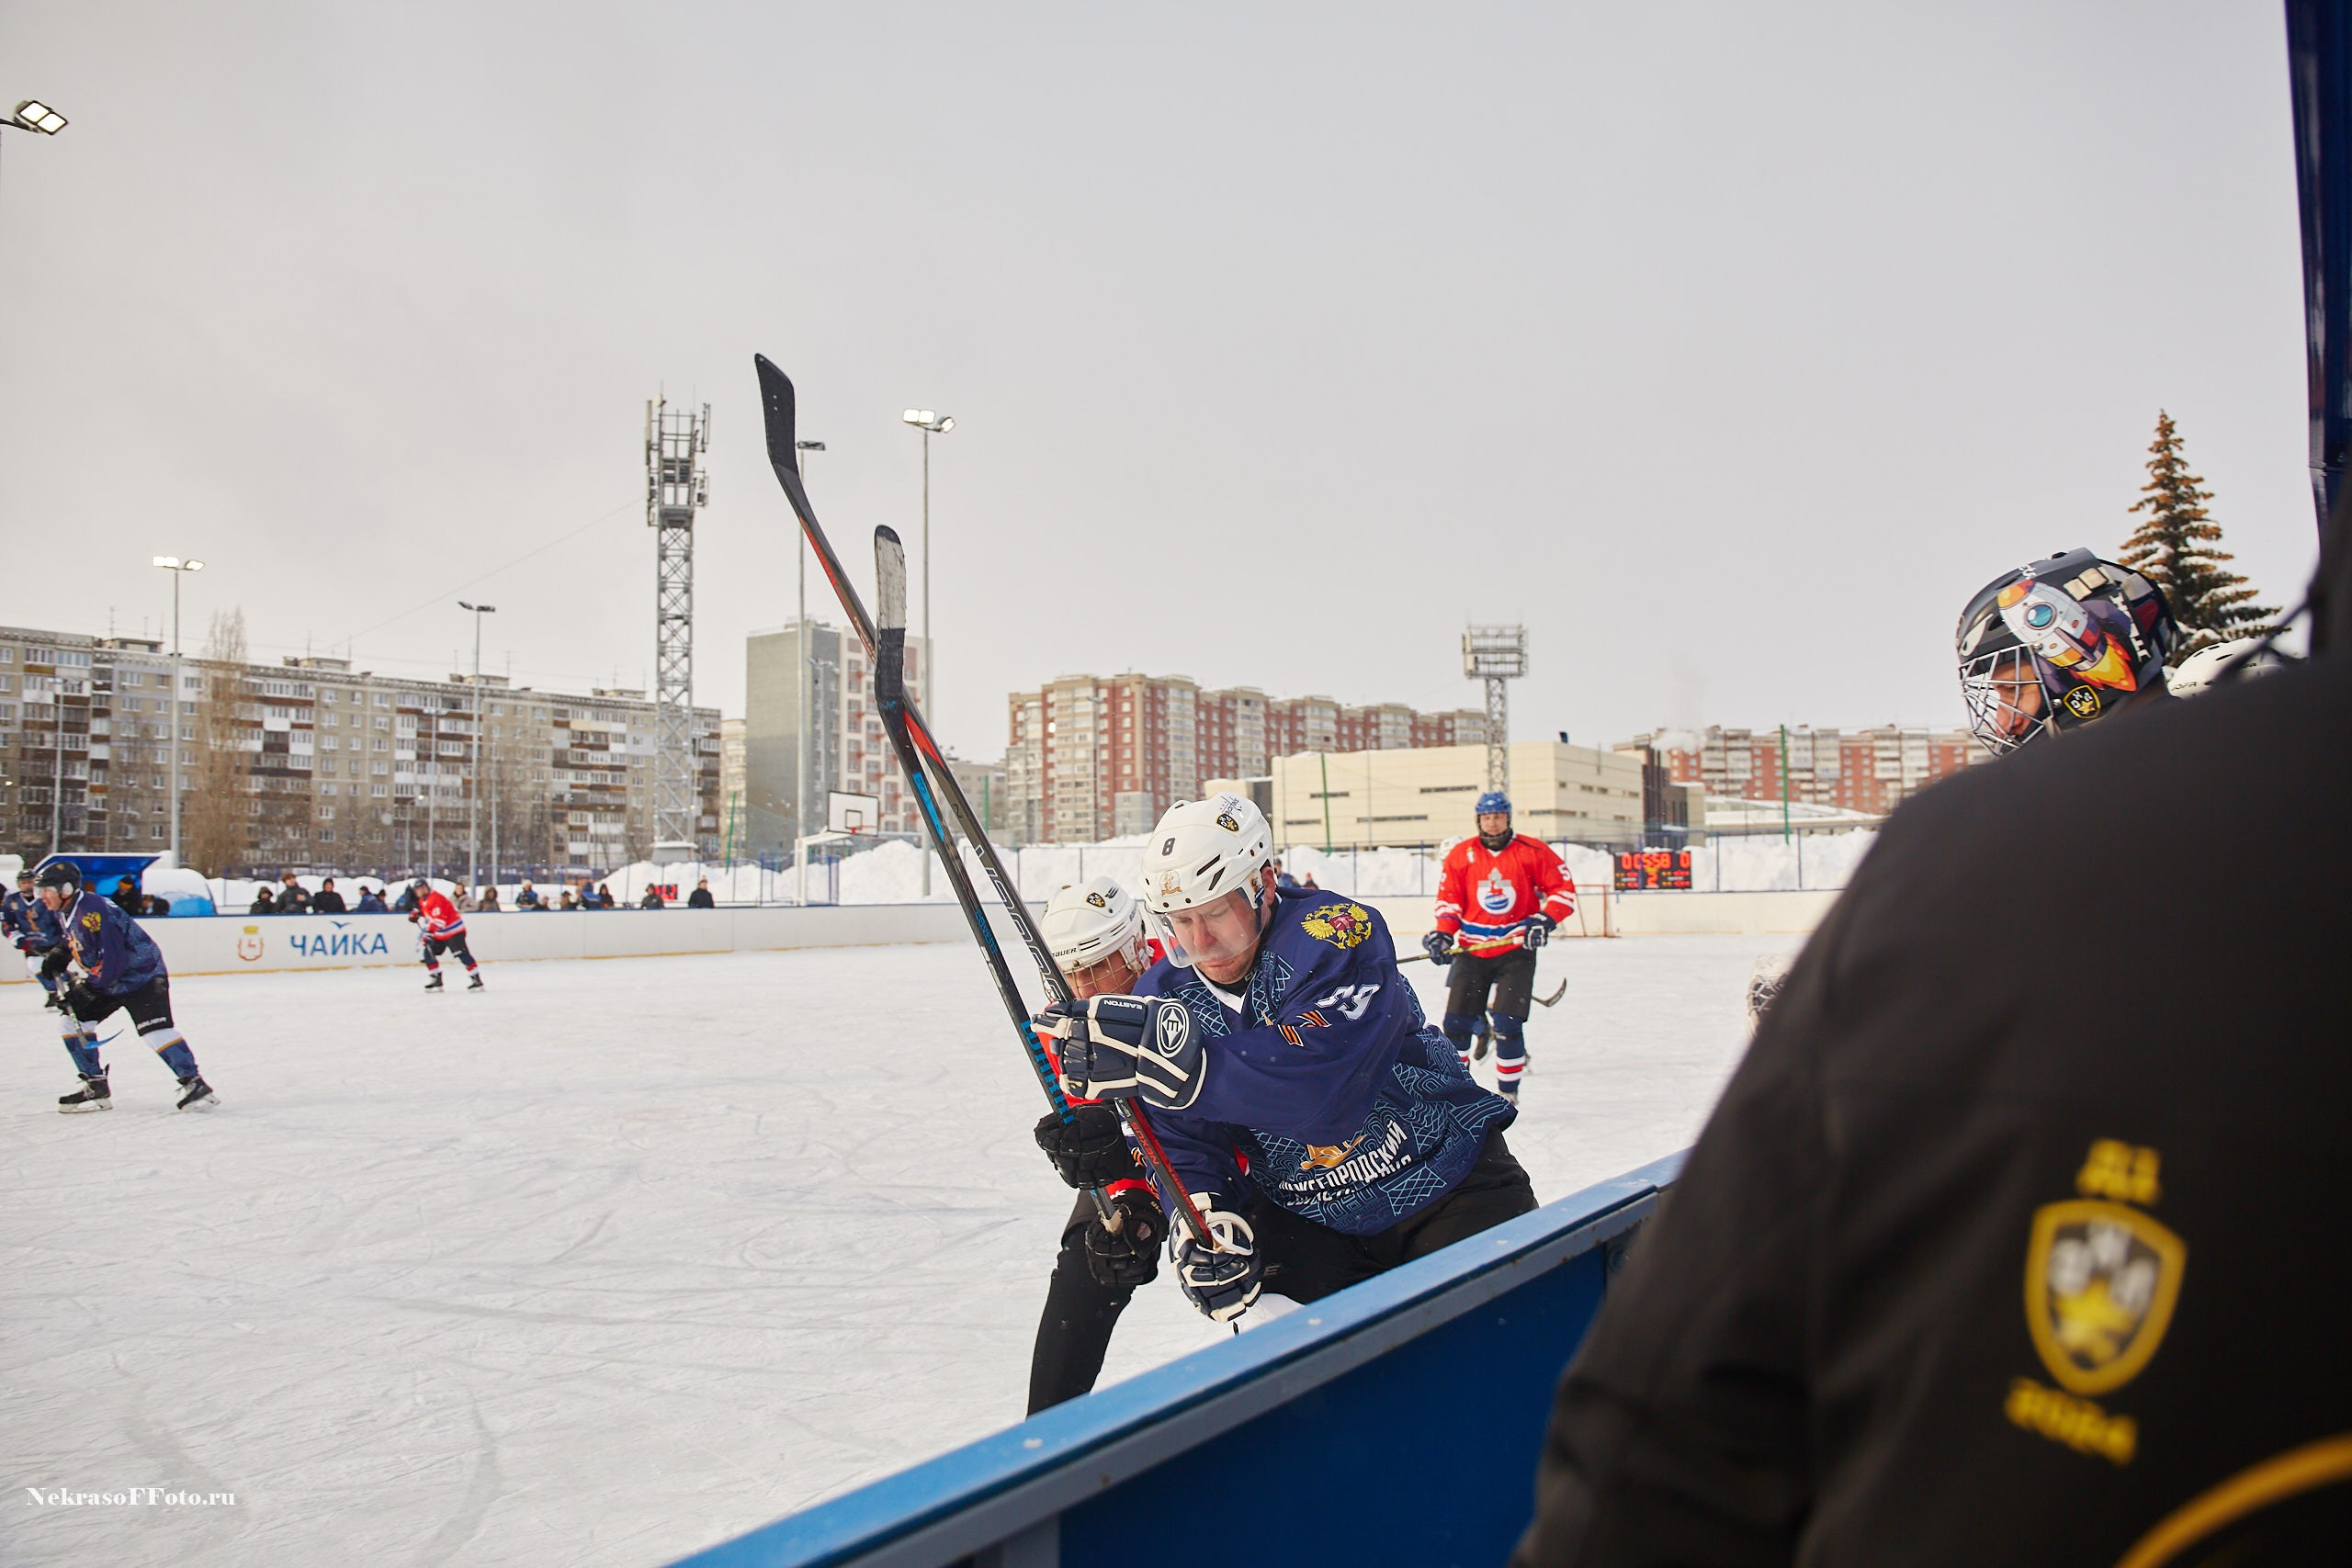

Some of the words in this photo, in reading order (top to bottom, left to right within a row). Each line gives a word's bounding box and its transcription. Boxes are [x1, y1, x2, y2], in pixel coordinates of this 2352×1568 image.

[1161, 837, 1176, 856] 8
[290, 921, 389, 957] ЧАЙКА
[975, 908, 999, 955] COVERT
[1103, 999, 1144, 1010] EASTON
[1129, 1122, 1159, 1165] NEXUS
